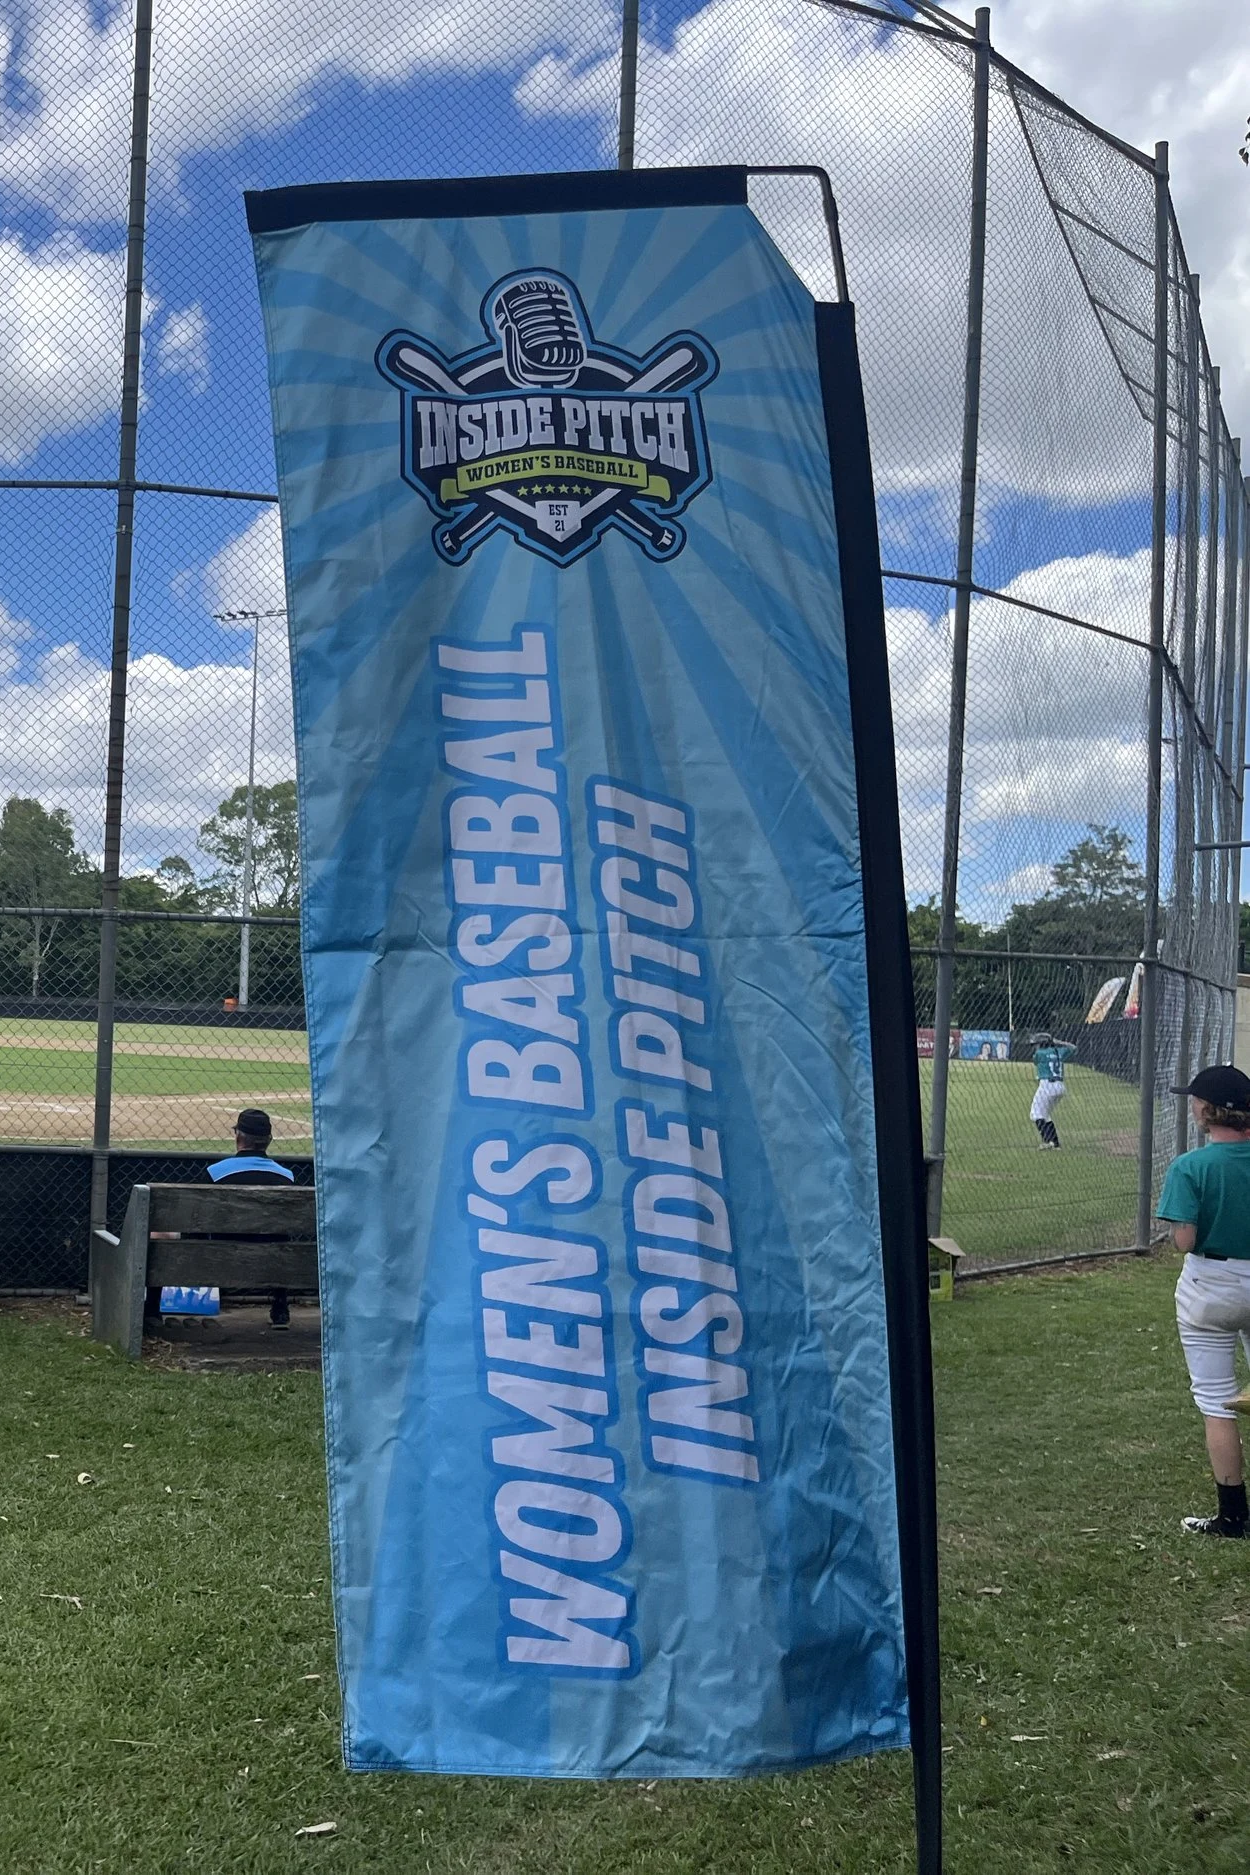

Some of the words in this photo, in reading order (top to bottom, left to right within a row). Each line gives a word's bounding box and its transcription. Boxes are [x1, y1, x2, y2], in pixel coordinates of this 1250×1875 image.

[416, 397, 556, 470] INSIDE
[560, 397, 690, 473] PITCH
[465, 455, 551, 483] WOMEN'S
[553, 456, 639, 480] BASEBALL
[548, 503, 569, 517] EST
[554, 519, 566, 532] 21
[438, 631, 585, 1111] BASEBALL
[594, 784, 713, 1092] PITCH
[624, 1108, 760, 1483] INSIDE
[467, 1139, 630, 1668] WOMEN'S
